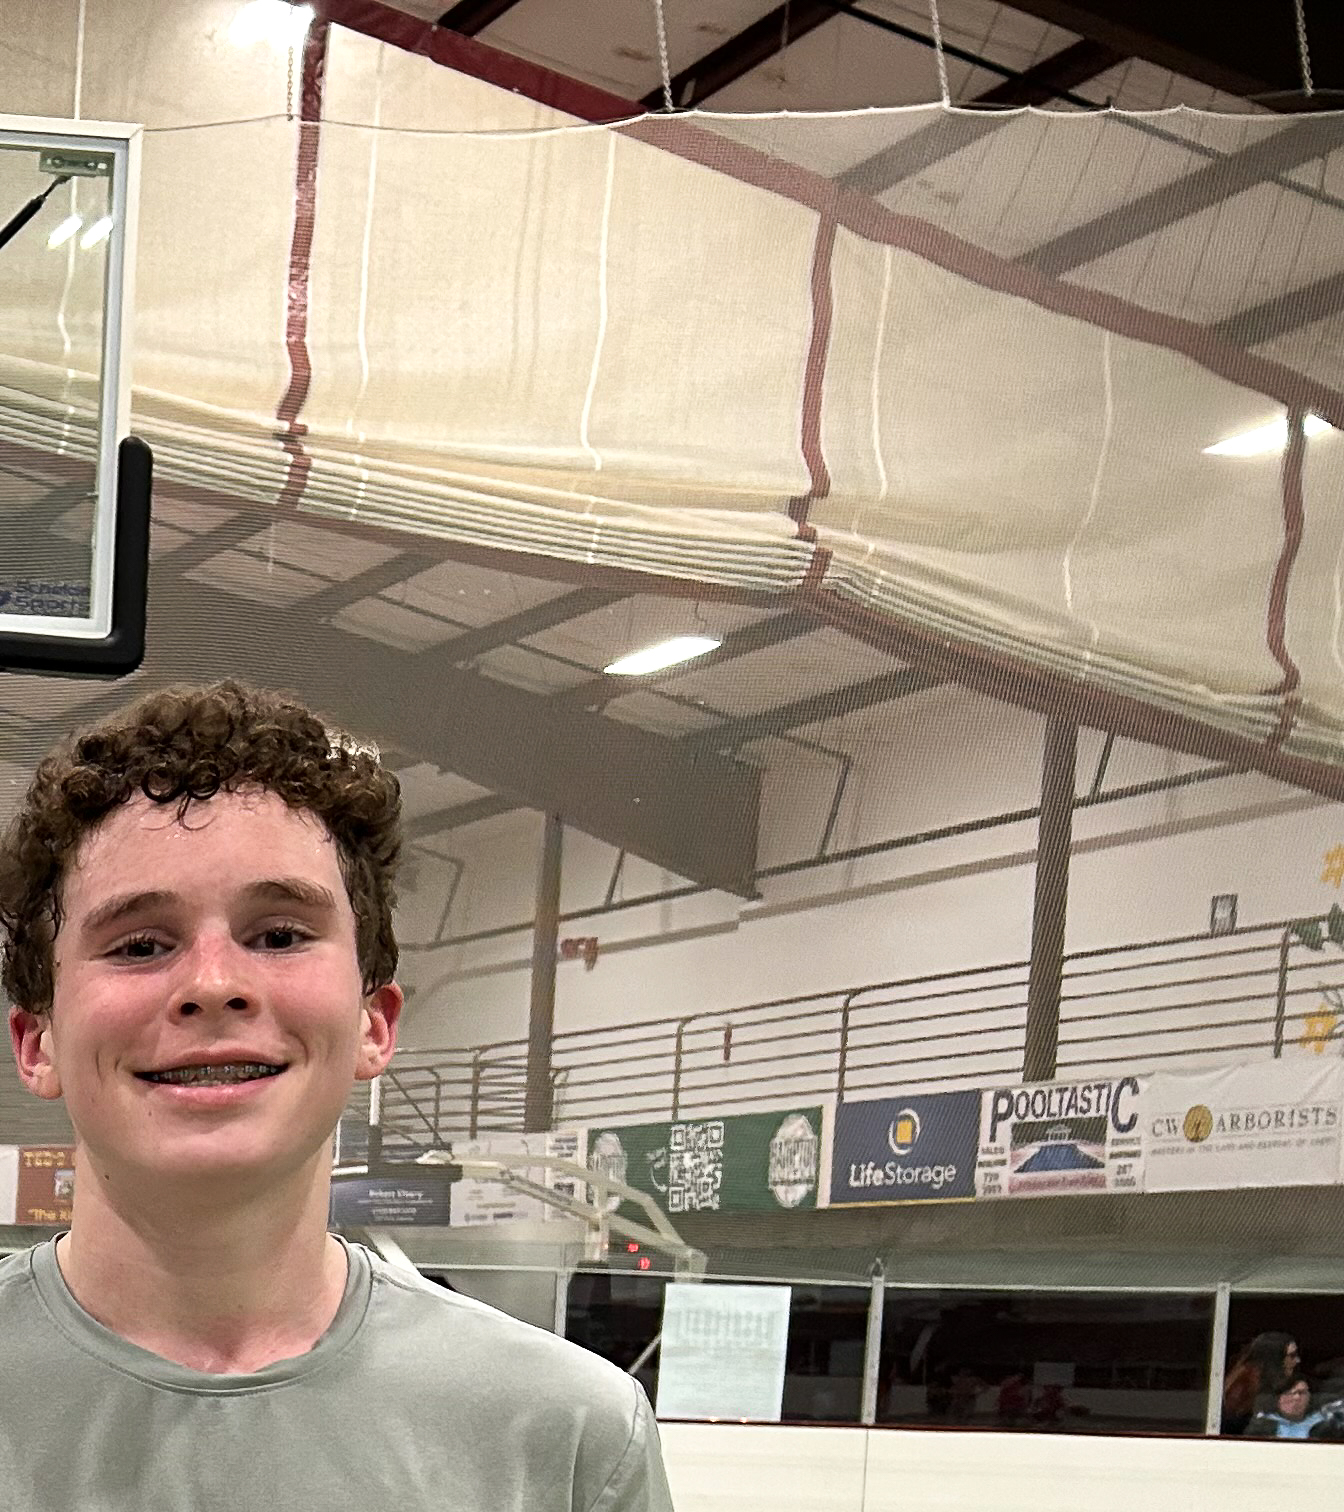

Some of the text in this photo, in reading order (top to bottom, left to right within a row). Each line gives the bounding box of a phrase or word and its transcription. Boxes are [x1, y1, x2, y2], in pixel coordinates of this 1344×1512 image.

[989, 1077, 1140, 1143] POOLTASTIC
[1151, 1106, 1338, 1138] CW ARBORISTS
